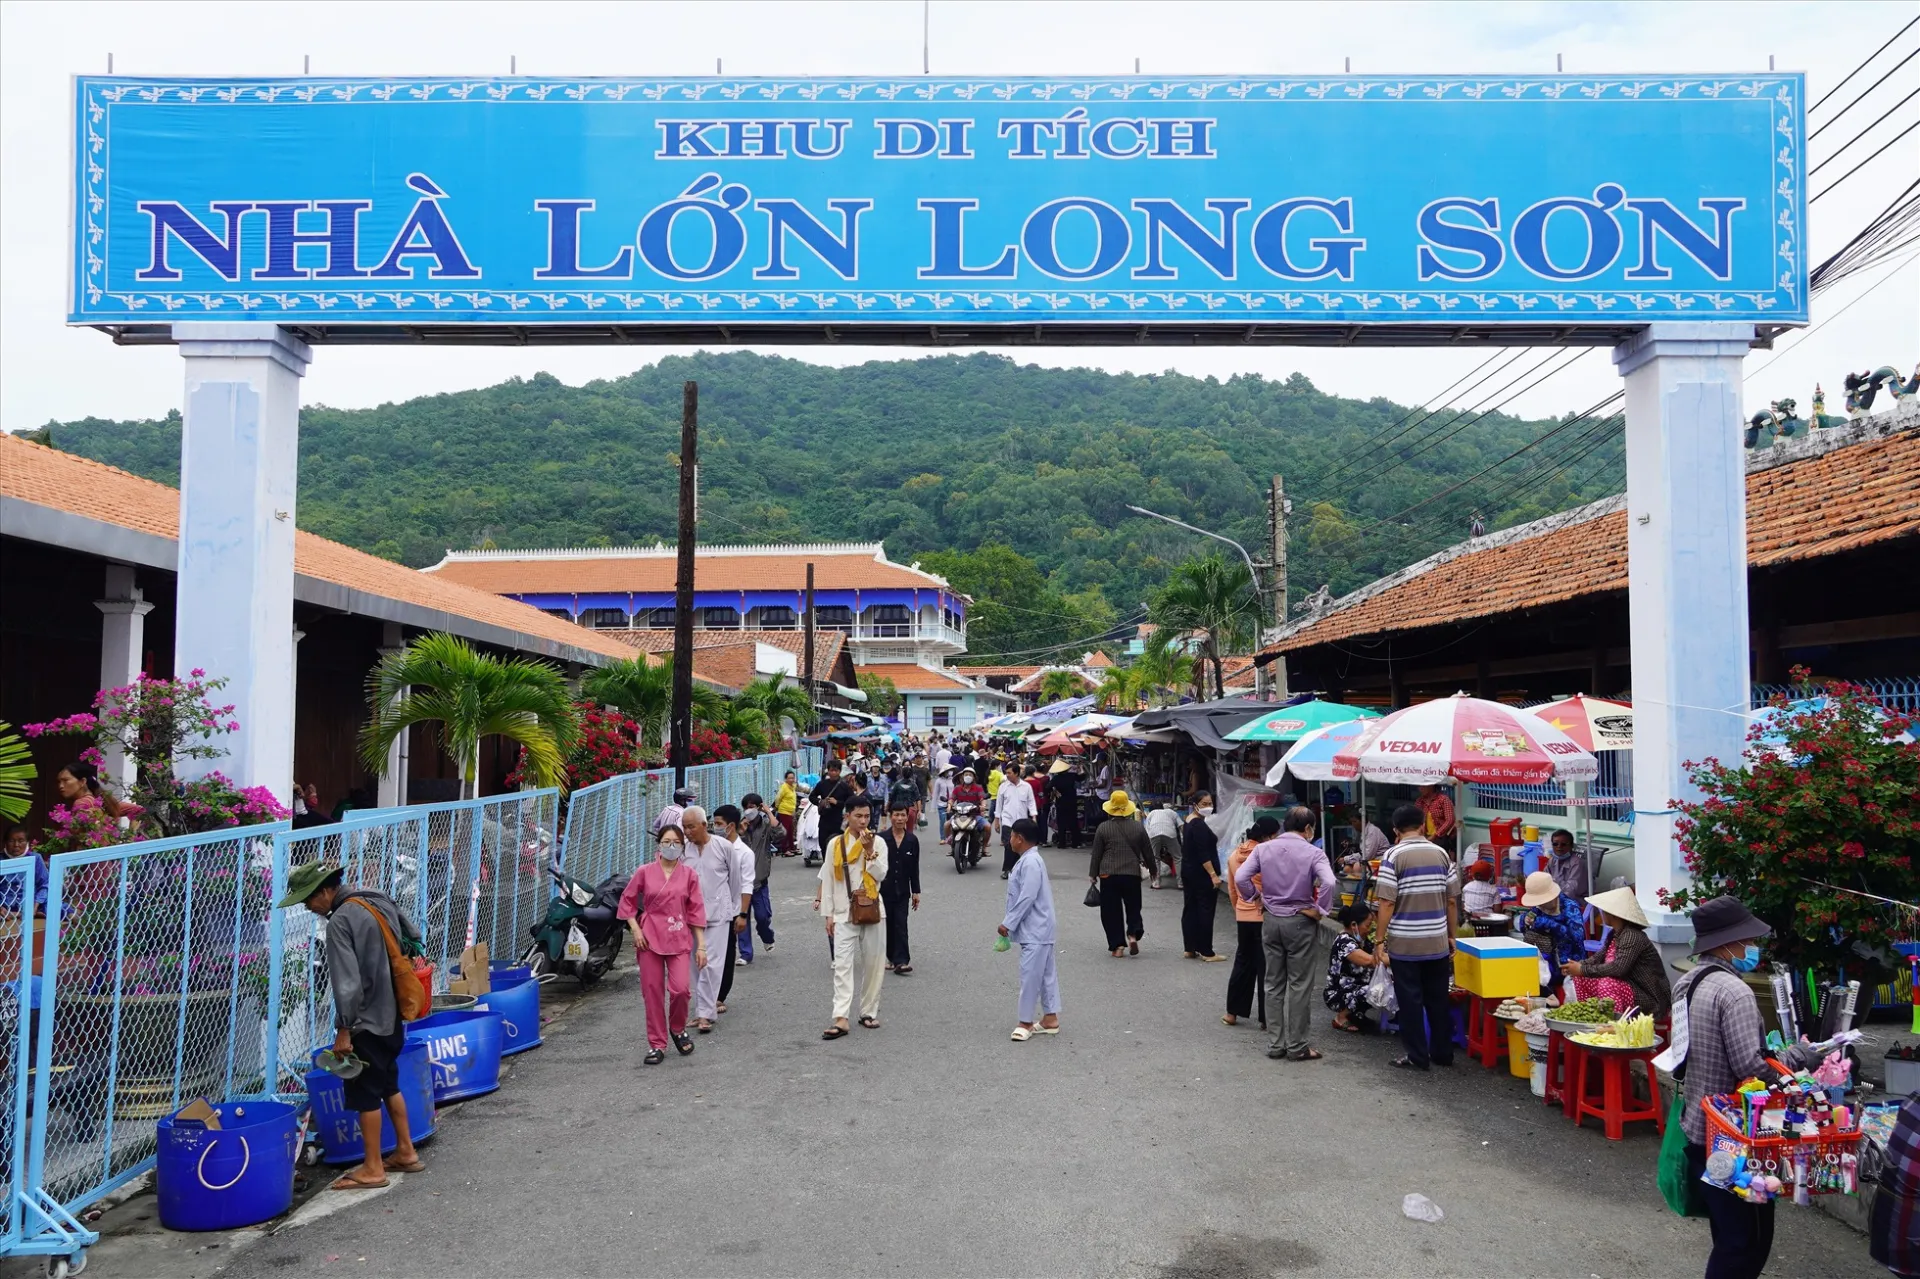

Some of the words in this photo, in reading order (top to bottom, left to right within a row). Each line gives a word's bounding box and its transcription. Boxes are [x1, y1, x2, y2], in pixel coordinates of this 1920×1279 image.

[654, 118, 853, 161] KHU
[873, 118, 976, 161] DI
[998, 106, 1219, 161] TÍCH
[135, 171, 483, 283] NHÀ
[533, 171, 875, 283] LỚN
[915, 195, 1367, 283] LONG
[1415, 182, 1747, 283] SƠN
[1380, 740, 1443, 754] VEDAN
[1542, 742, 1582, 755] VEDAN
[426, 1034, 468, 1062] ÙNG
